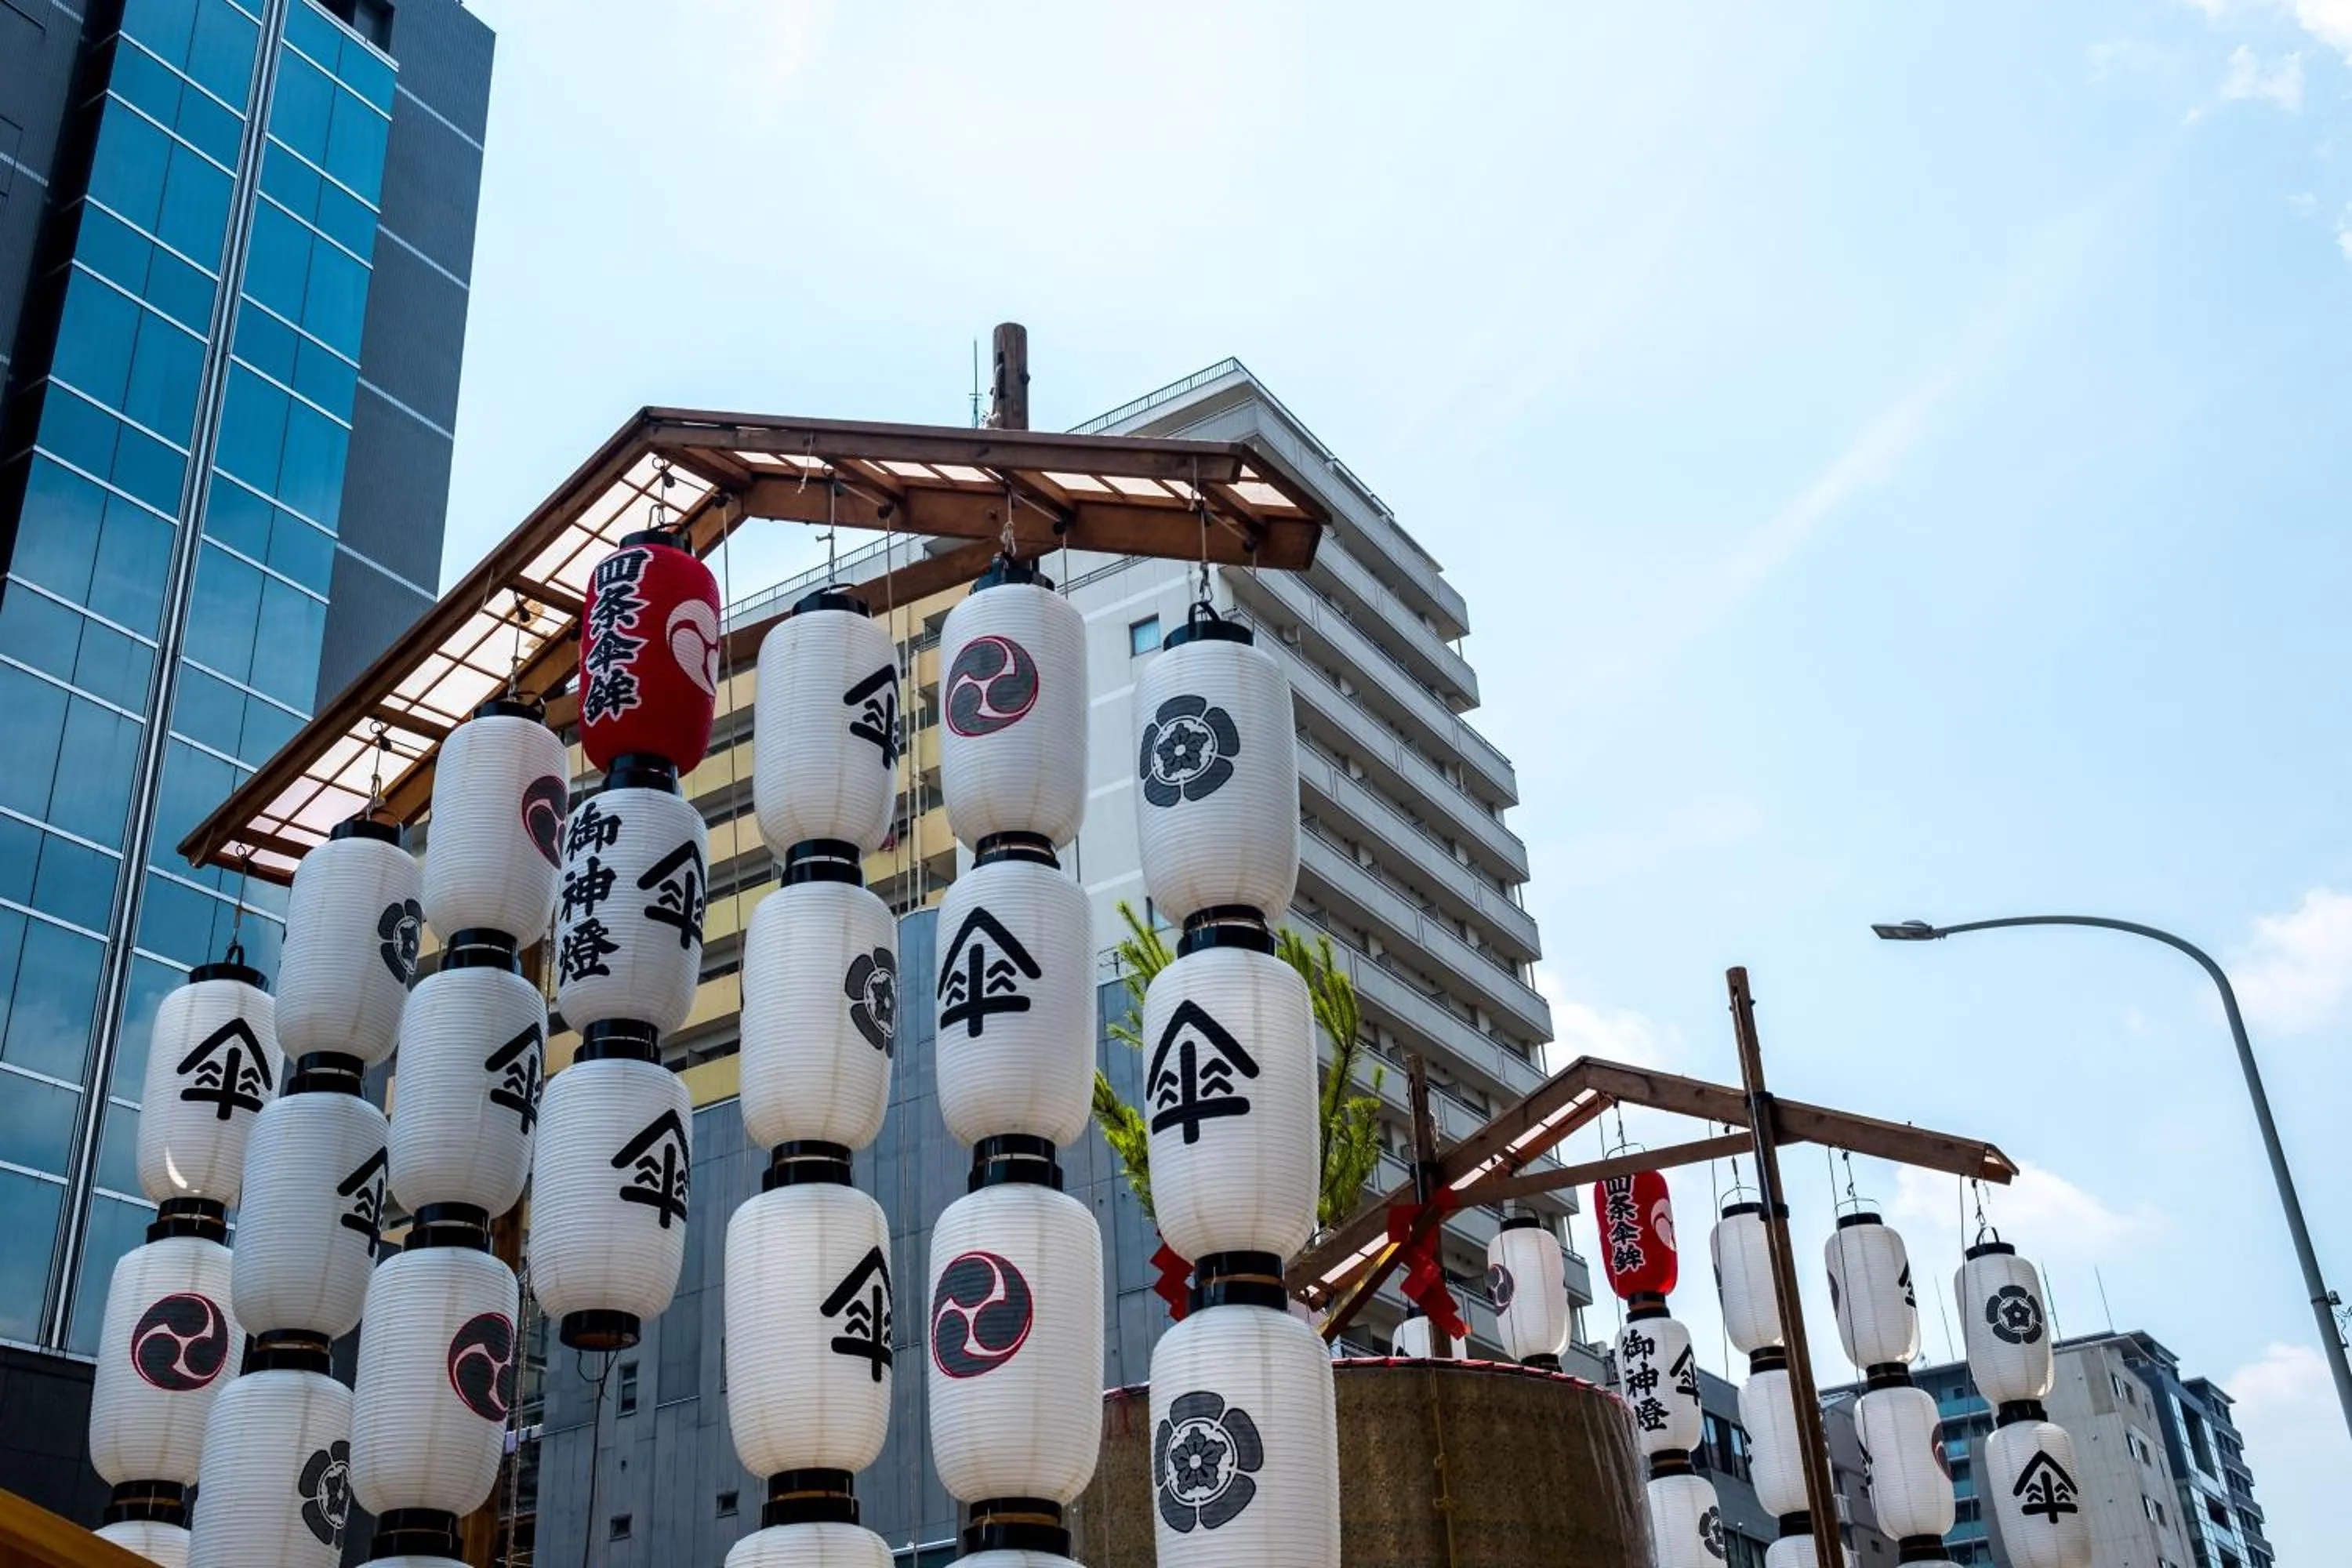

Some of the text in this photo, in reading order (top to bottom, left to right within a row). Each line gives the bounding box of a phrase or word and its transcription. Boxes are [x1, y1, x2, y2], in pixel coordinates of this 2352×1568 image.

[585, 547, 653, 727] 四条傘鉾
[559, 801, 622, 987] 御神燈
[637, 840, 706, 950] 傘
[937, 906, 1041, 1037] 傘
[177, 1018, 272, 1120] 傘
[1145, 999, 1259, 1145] 傘
[611, 1109, 691, 1229] 傘
[820, 1246, 892, 1382] 傘
[2013, 1450, 2078, 1524] 傘
